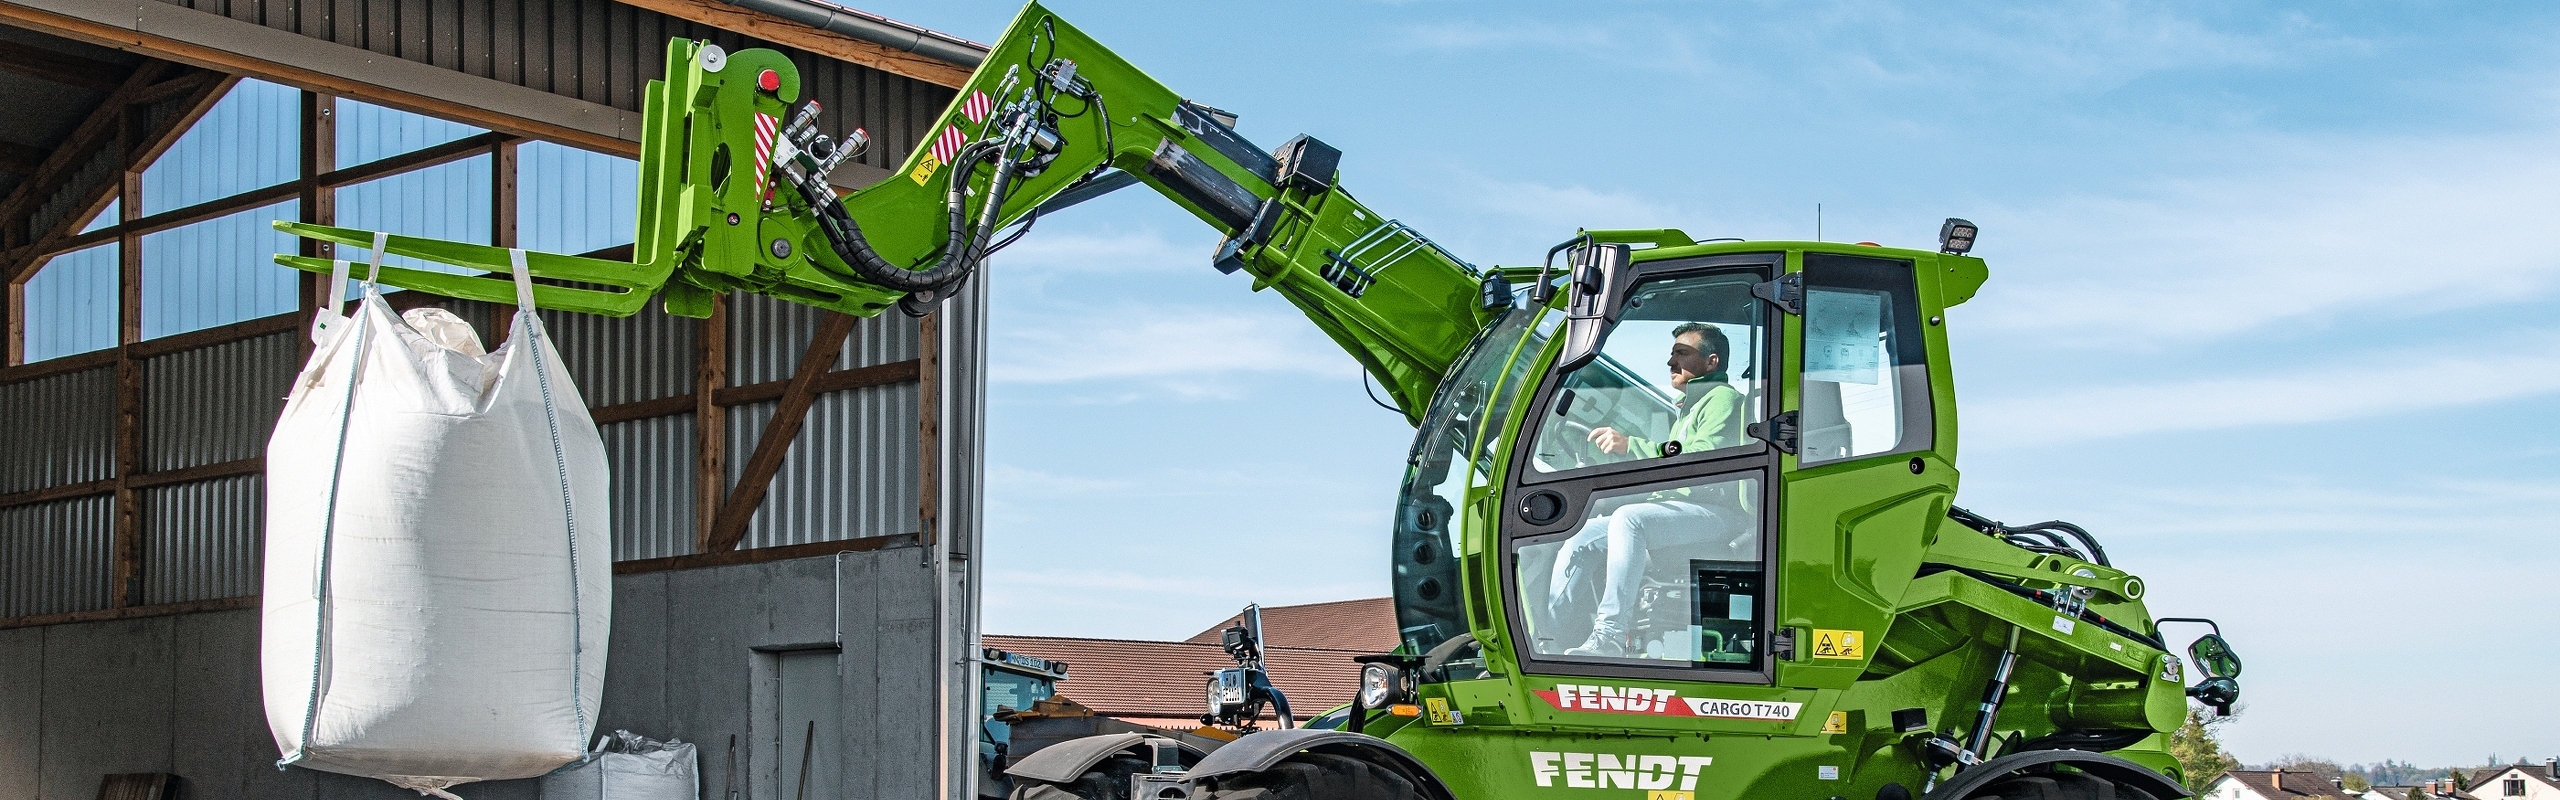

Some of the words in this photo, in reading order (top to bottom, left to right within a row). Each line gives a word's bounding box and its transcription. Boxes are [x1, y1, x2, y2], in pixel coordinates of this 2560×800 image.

[1556, 684, 1676, 713] FENDT
[1700, 702, 1752, 716] CARGO
[1755, 704, 1790, 717] T740
[1529, 751, 1713, 790] FENDT
